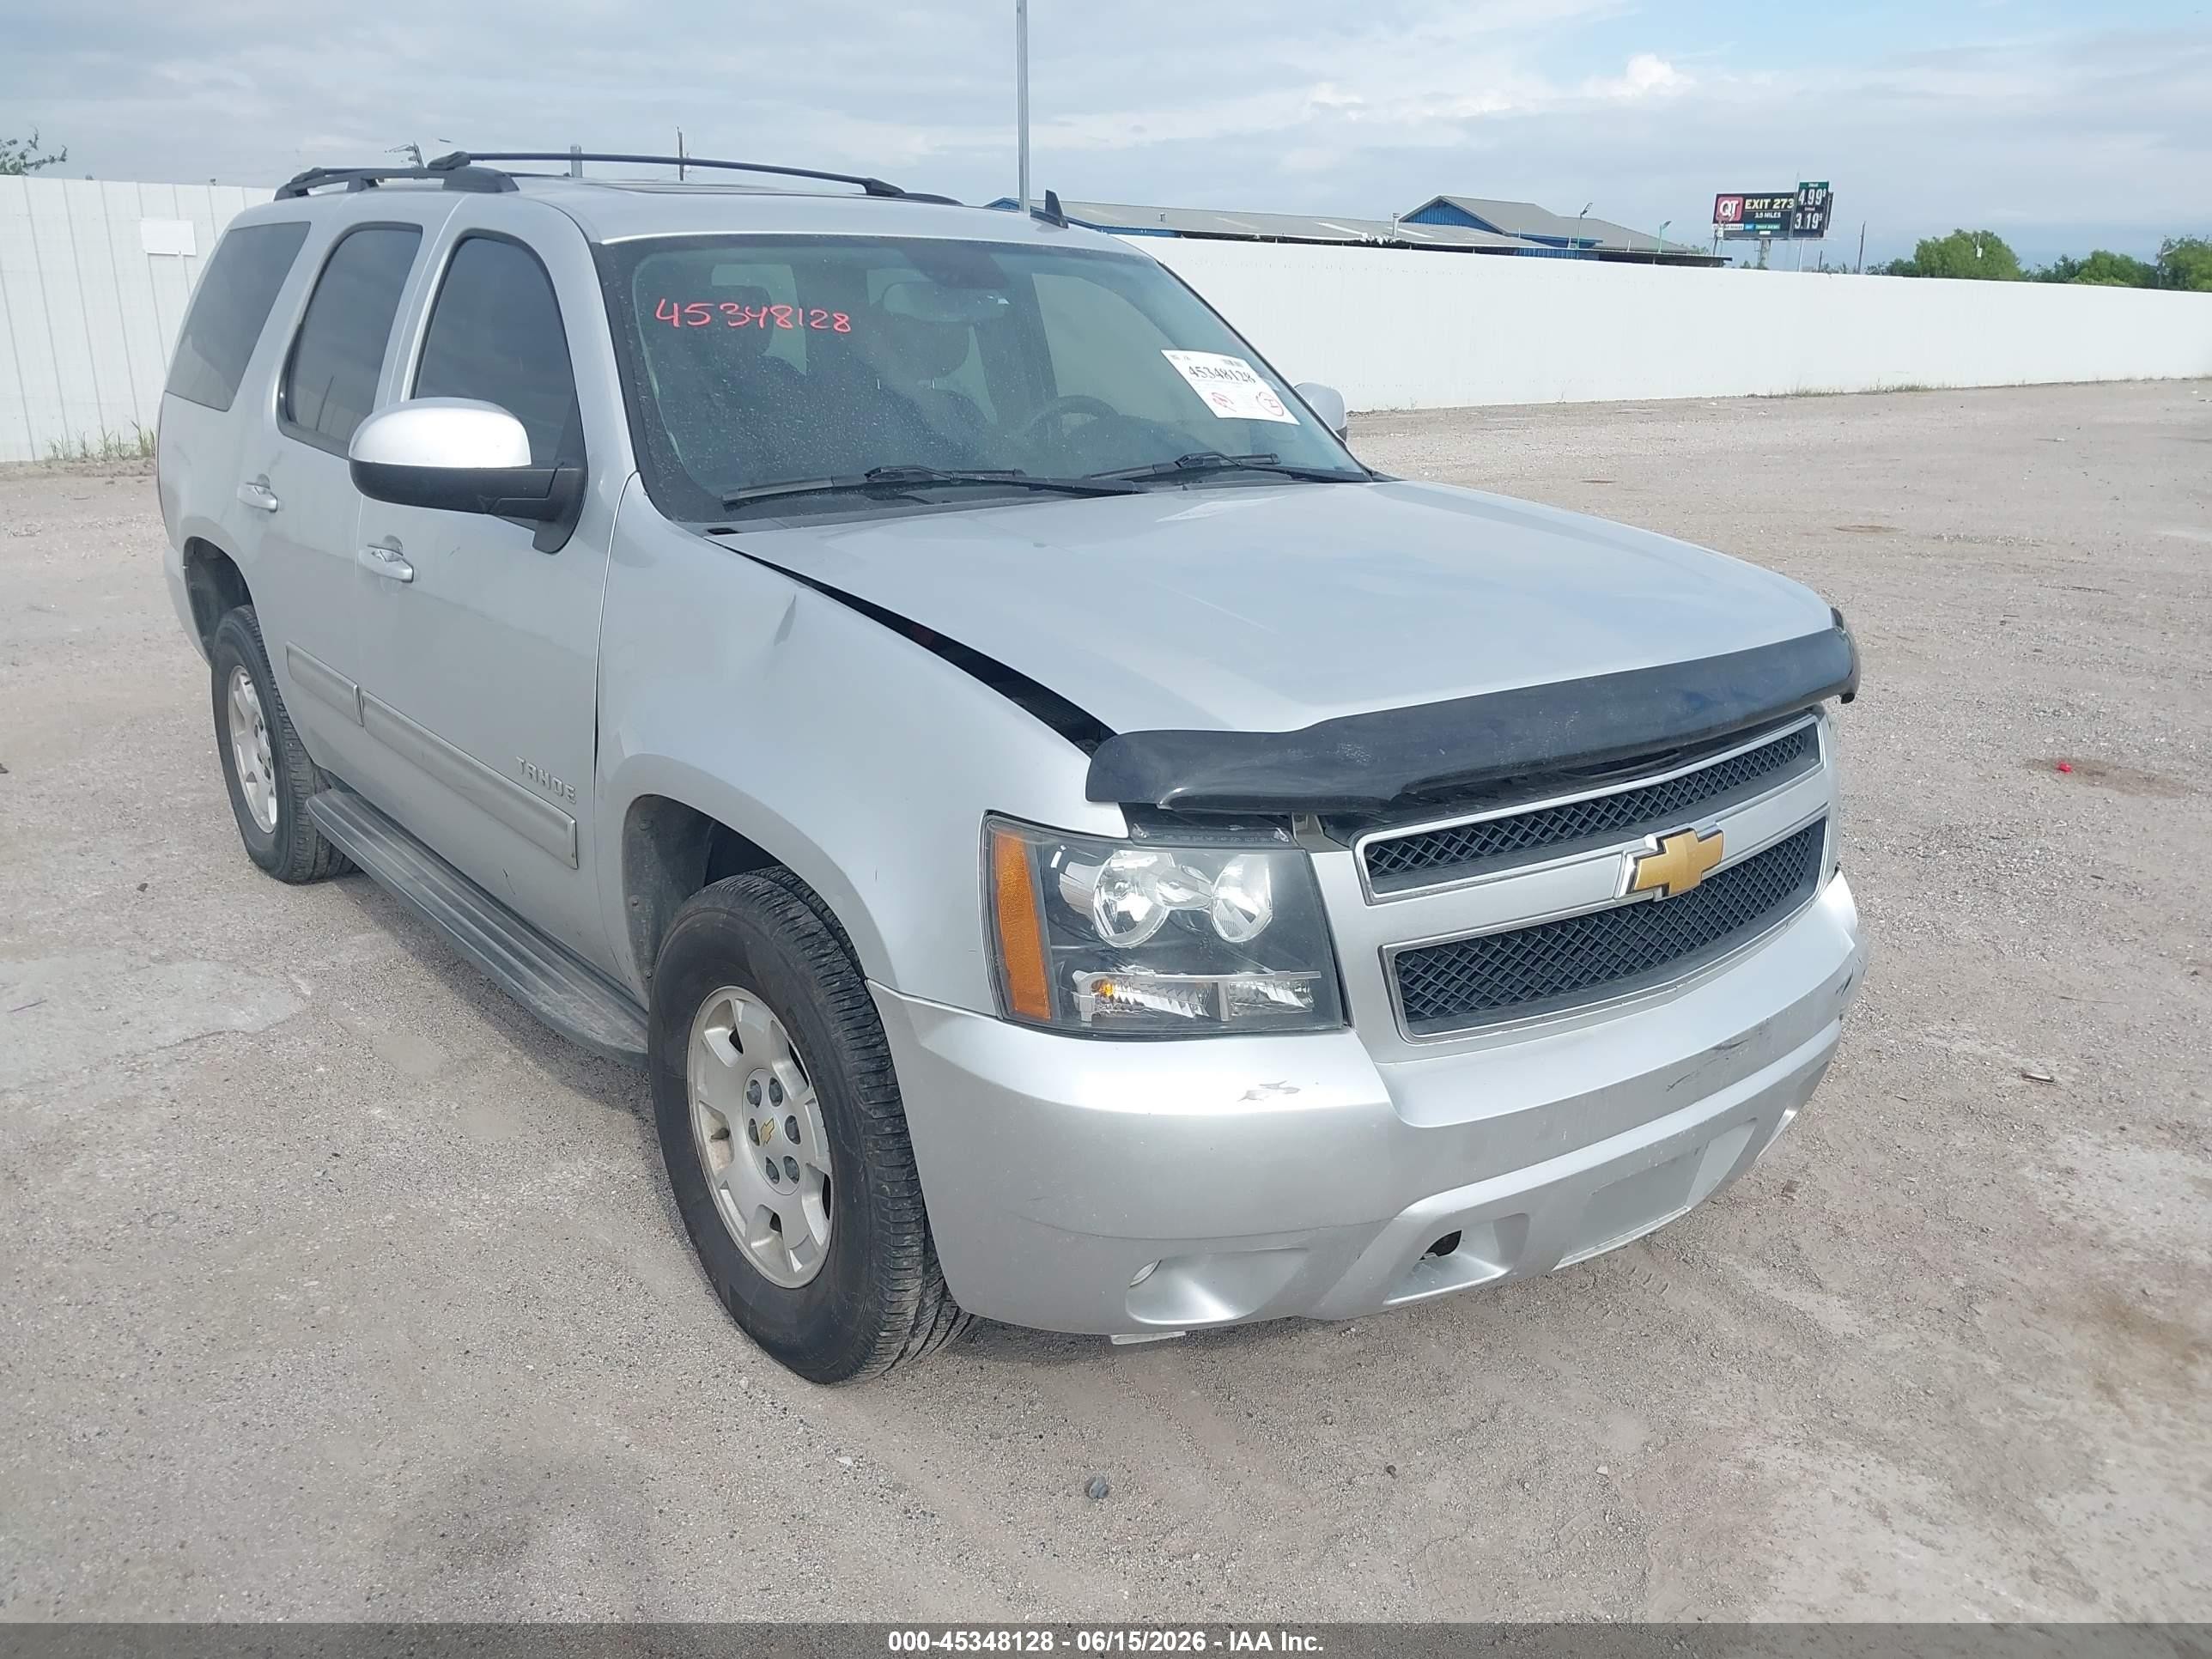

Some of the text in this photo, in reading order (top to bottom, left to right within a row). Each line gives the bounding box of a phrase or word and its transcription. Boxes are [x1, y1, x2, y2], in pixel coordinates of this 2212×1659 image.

[1719, 200, 1739, 221] QT
[1745, 198, 1794, 210] EXIT 273
[655, 299, 851, 332] 45348128
[1188, 366, 1256, 384] 45348128
[516, 756, 576, 805] TAHOE
